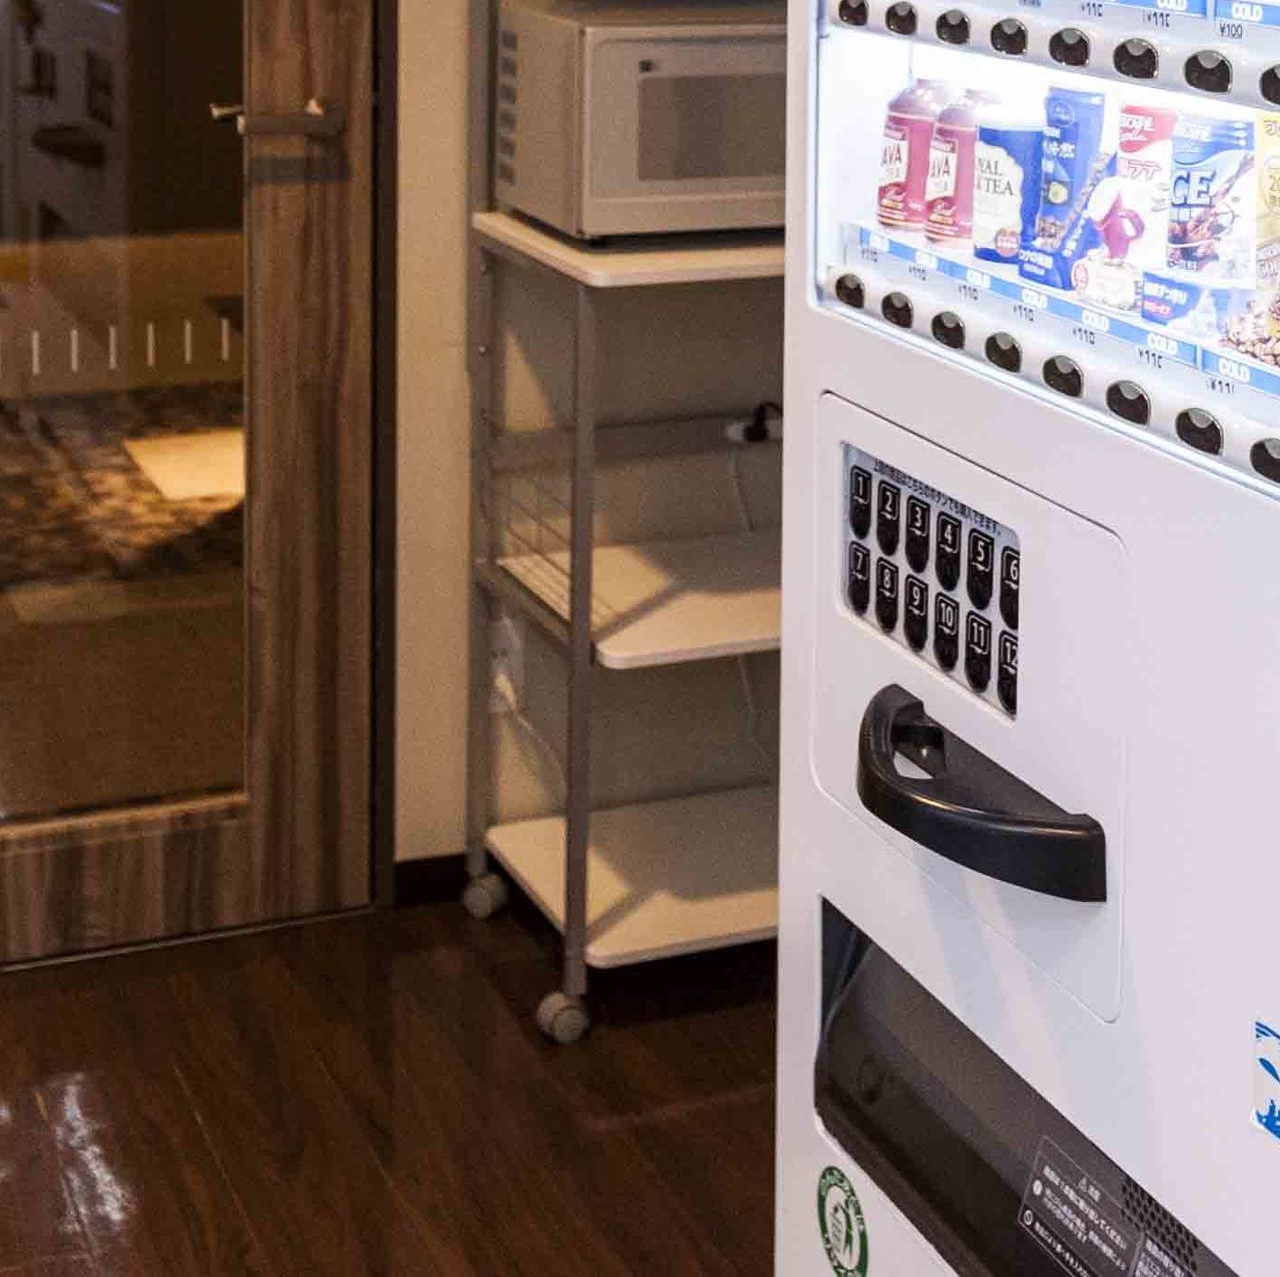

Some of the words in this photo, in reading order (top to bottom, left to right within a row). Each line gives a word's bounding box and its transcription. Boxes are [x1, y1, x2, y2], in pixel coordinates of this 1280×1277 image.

[1231, 2, 1264, 21] COLD
[1220, 22, 1244, 39] ¥100
[1147, 332, 1178, 357] COLD
[1218, 357, 1250, 383] COLD
